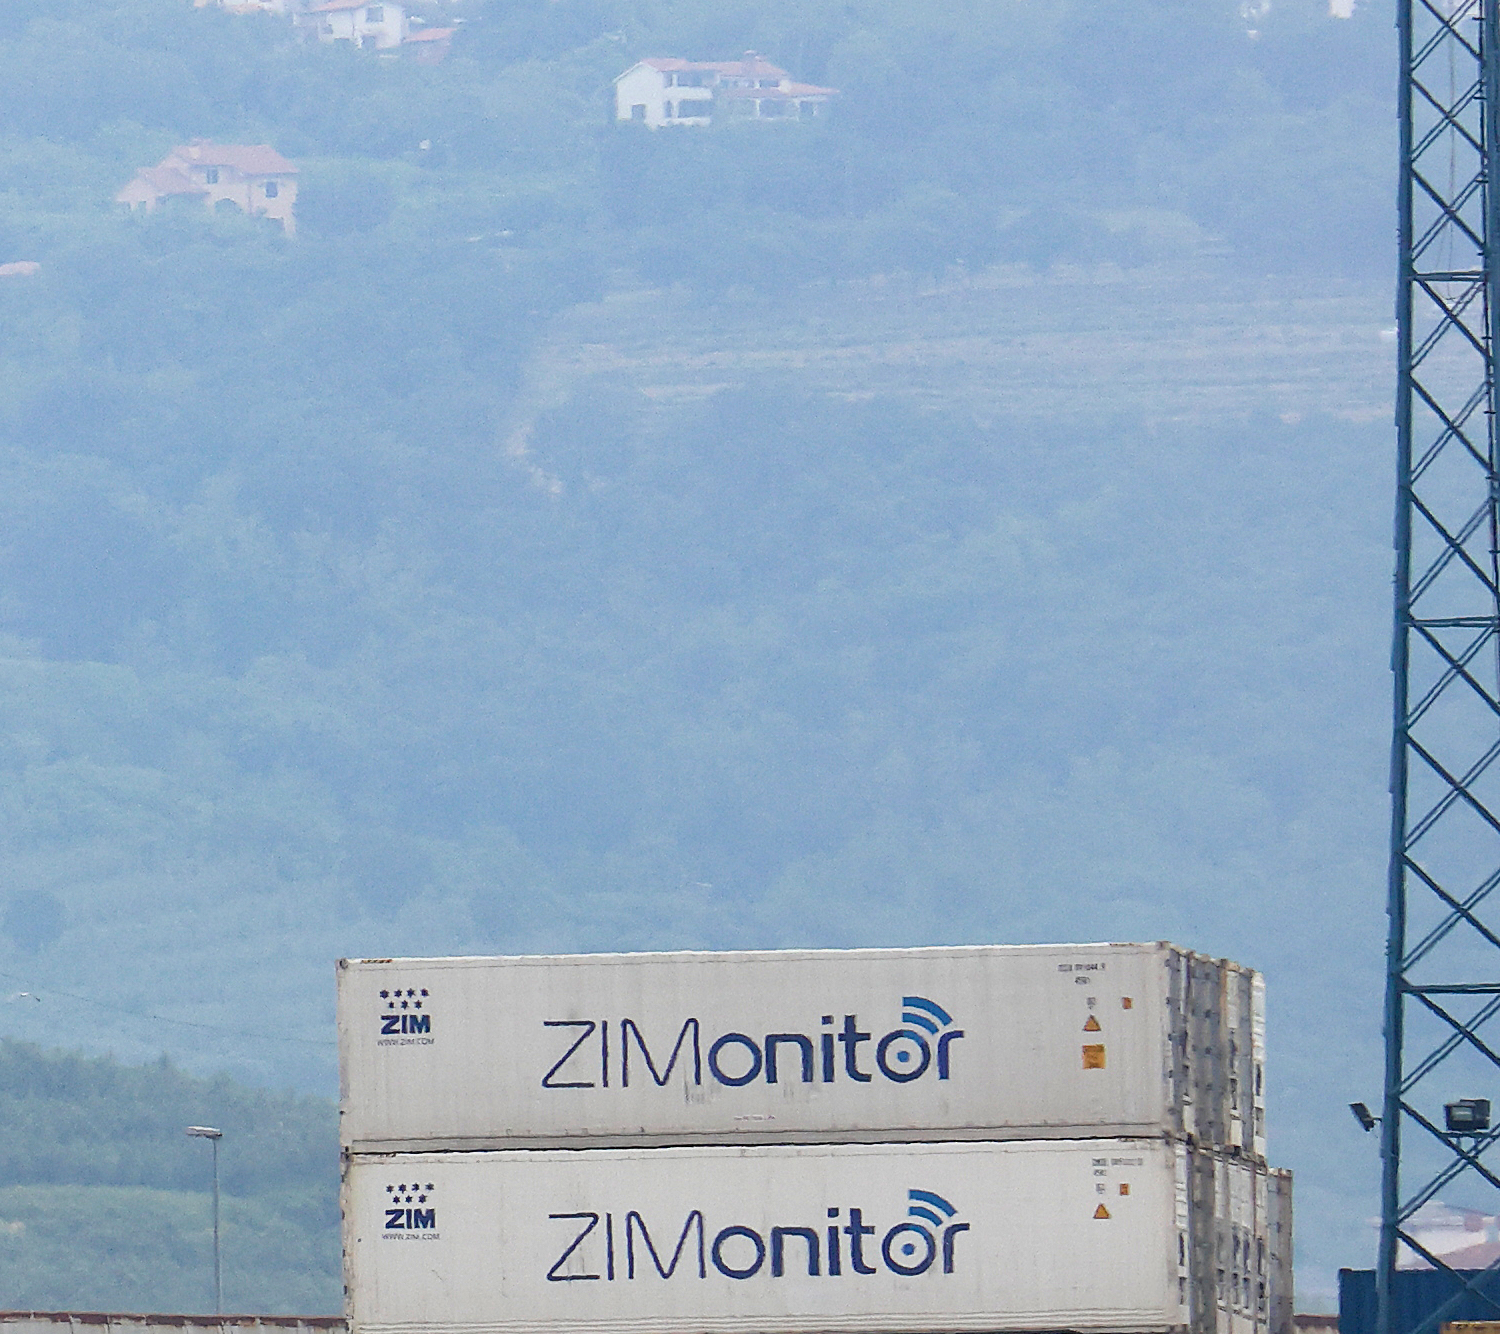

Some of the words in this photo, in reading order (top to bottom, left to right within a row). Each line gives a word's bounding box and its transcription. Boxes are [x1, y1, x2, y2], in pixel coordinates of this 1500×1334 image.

[380, 1014, 431, 1035] ZIM
[542, 1013, 965, 1088] ZIMonitor
[384, 1208, 436, 1230] ZIM
[546, 1206, 971, 1281] ZIMonitor
